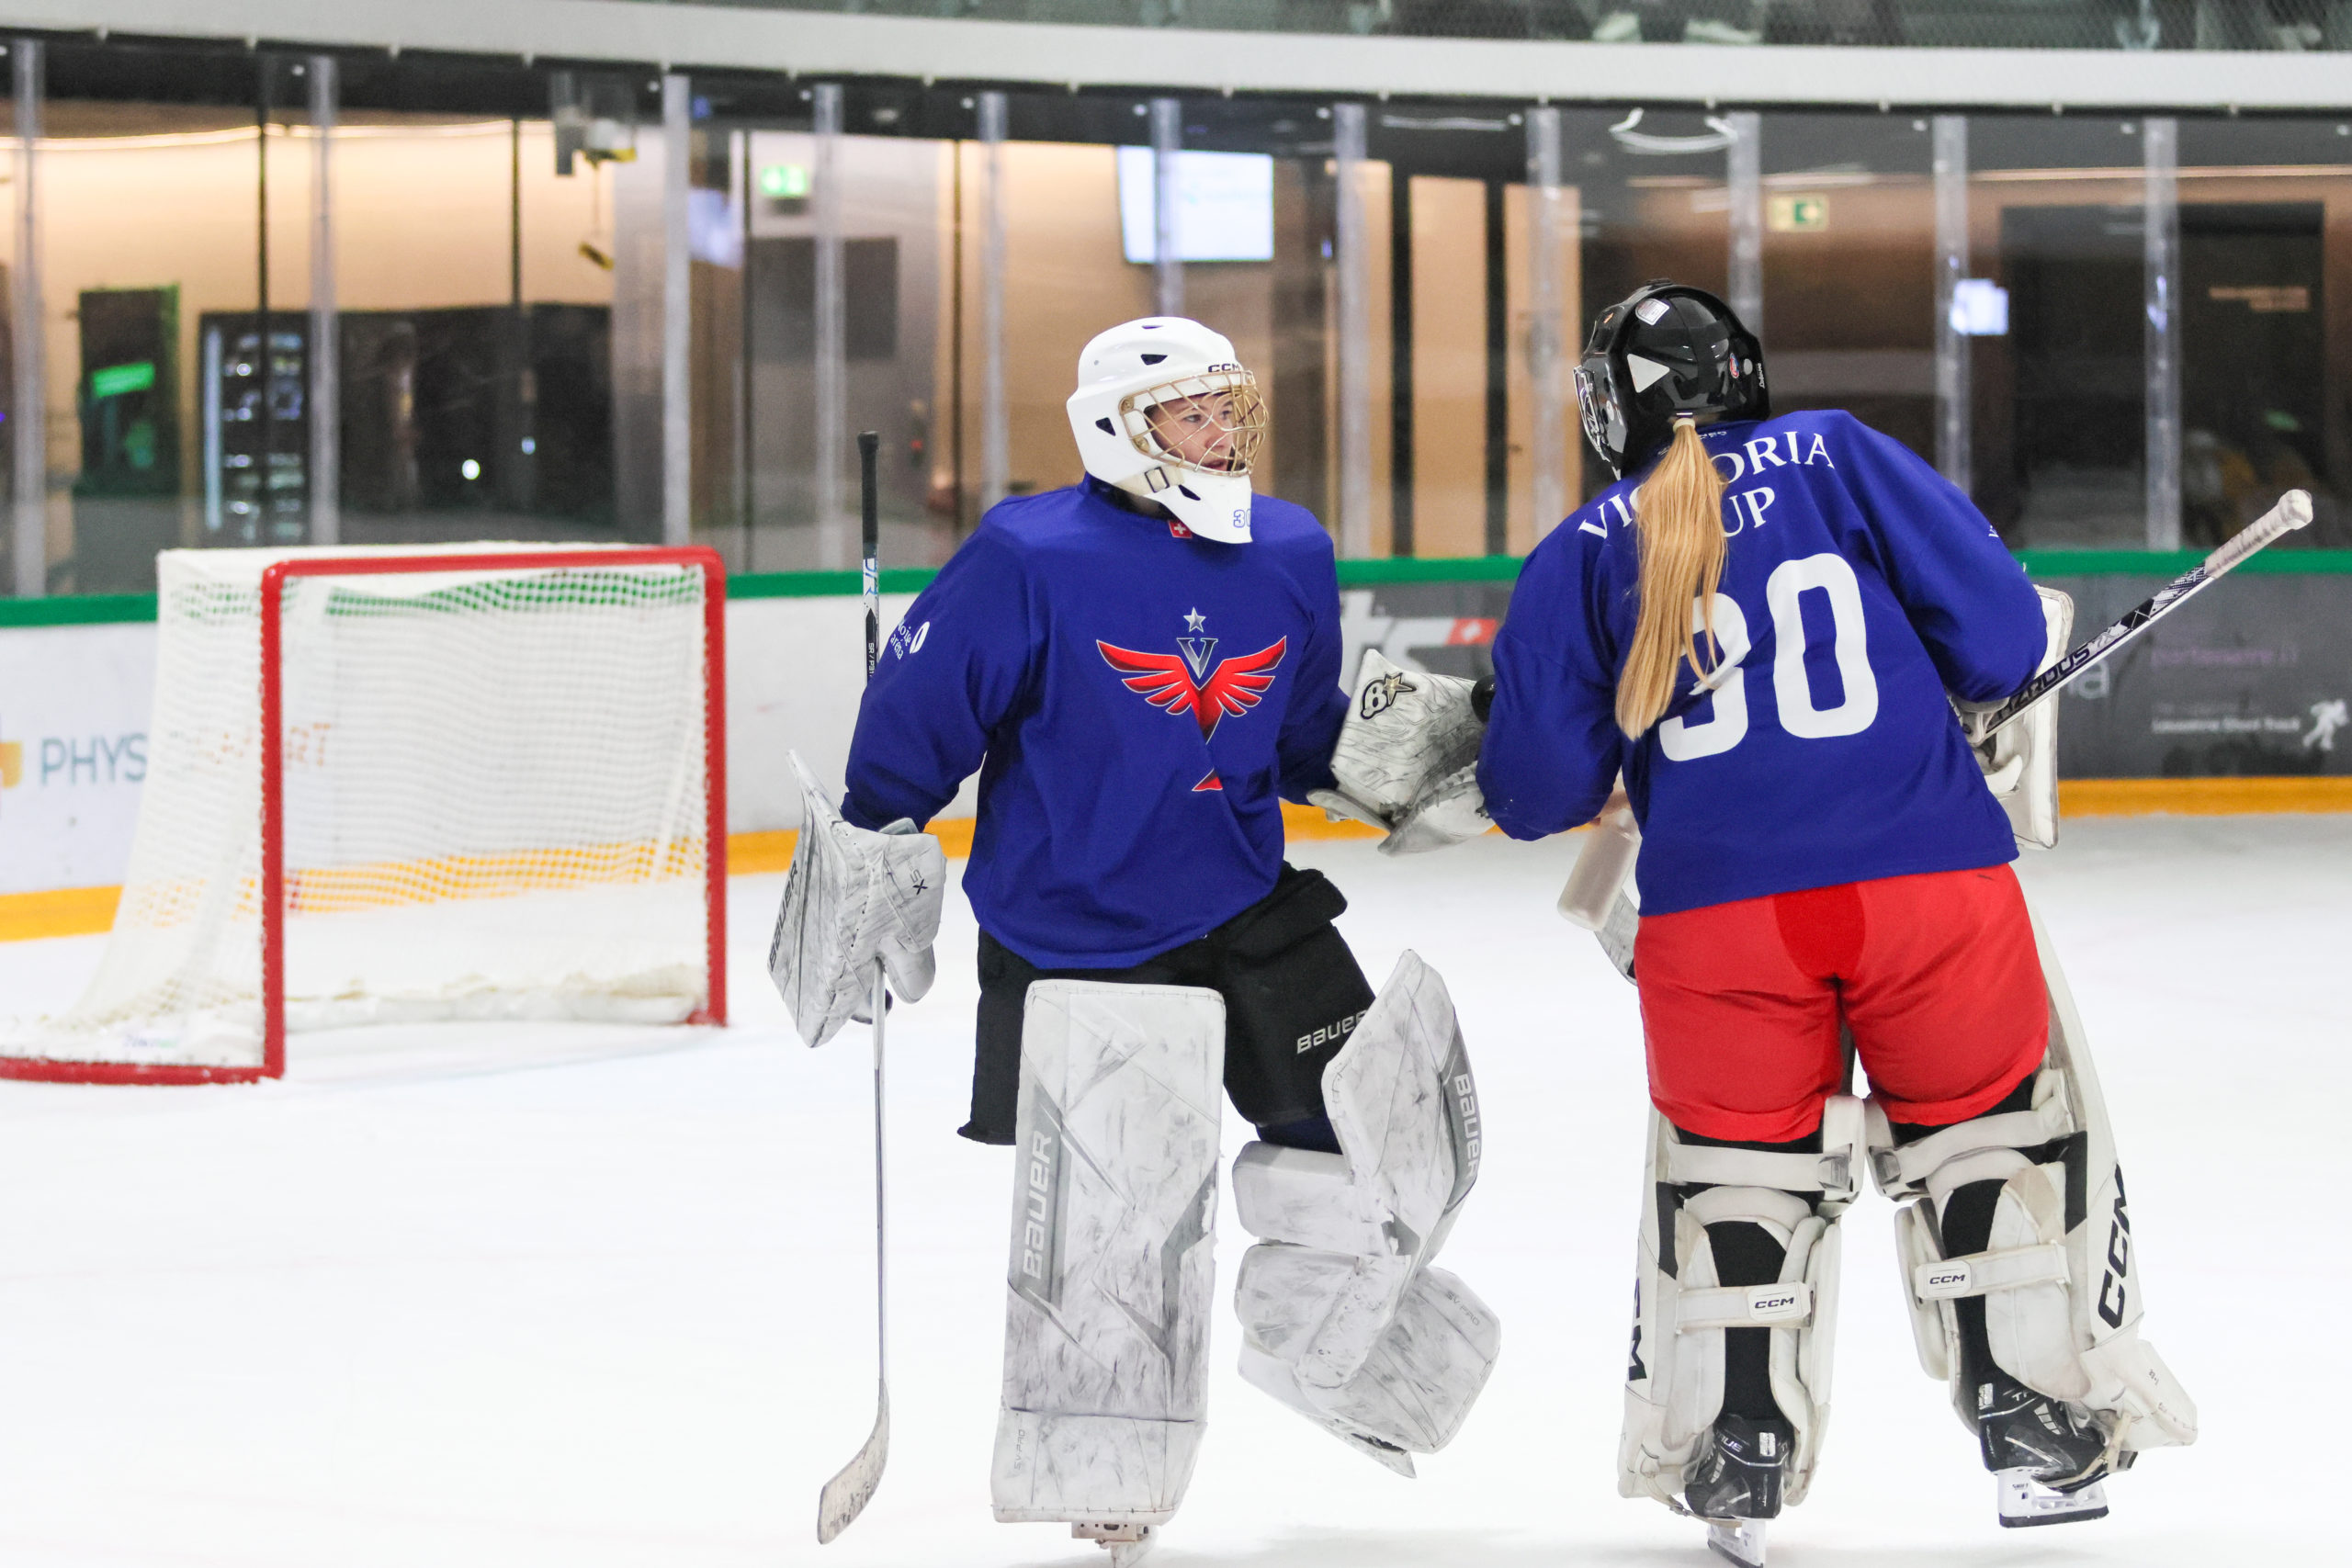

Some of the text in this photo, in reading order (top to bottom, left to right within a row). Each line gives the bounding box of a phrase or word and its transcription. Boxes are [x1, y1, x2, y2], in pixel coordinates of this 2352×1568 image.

[1577, 431, 1835, 540] VIORIA
[1723, 487, 1775, 537] UP
[1659, 553, 1879, 761] 30
[1023, 1130, 1052, 1280] BAUER
[1755, 1297, 1794, 1309] CCM
[1929, 1274, 1965, 1284] CCM
